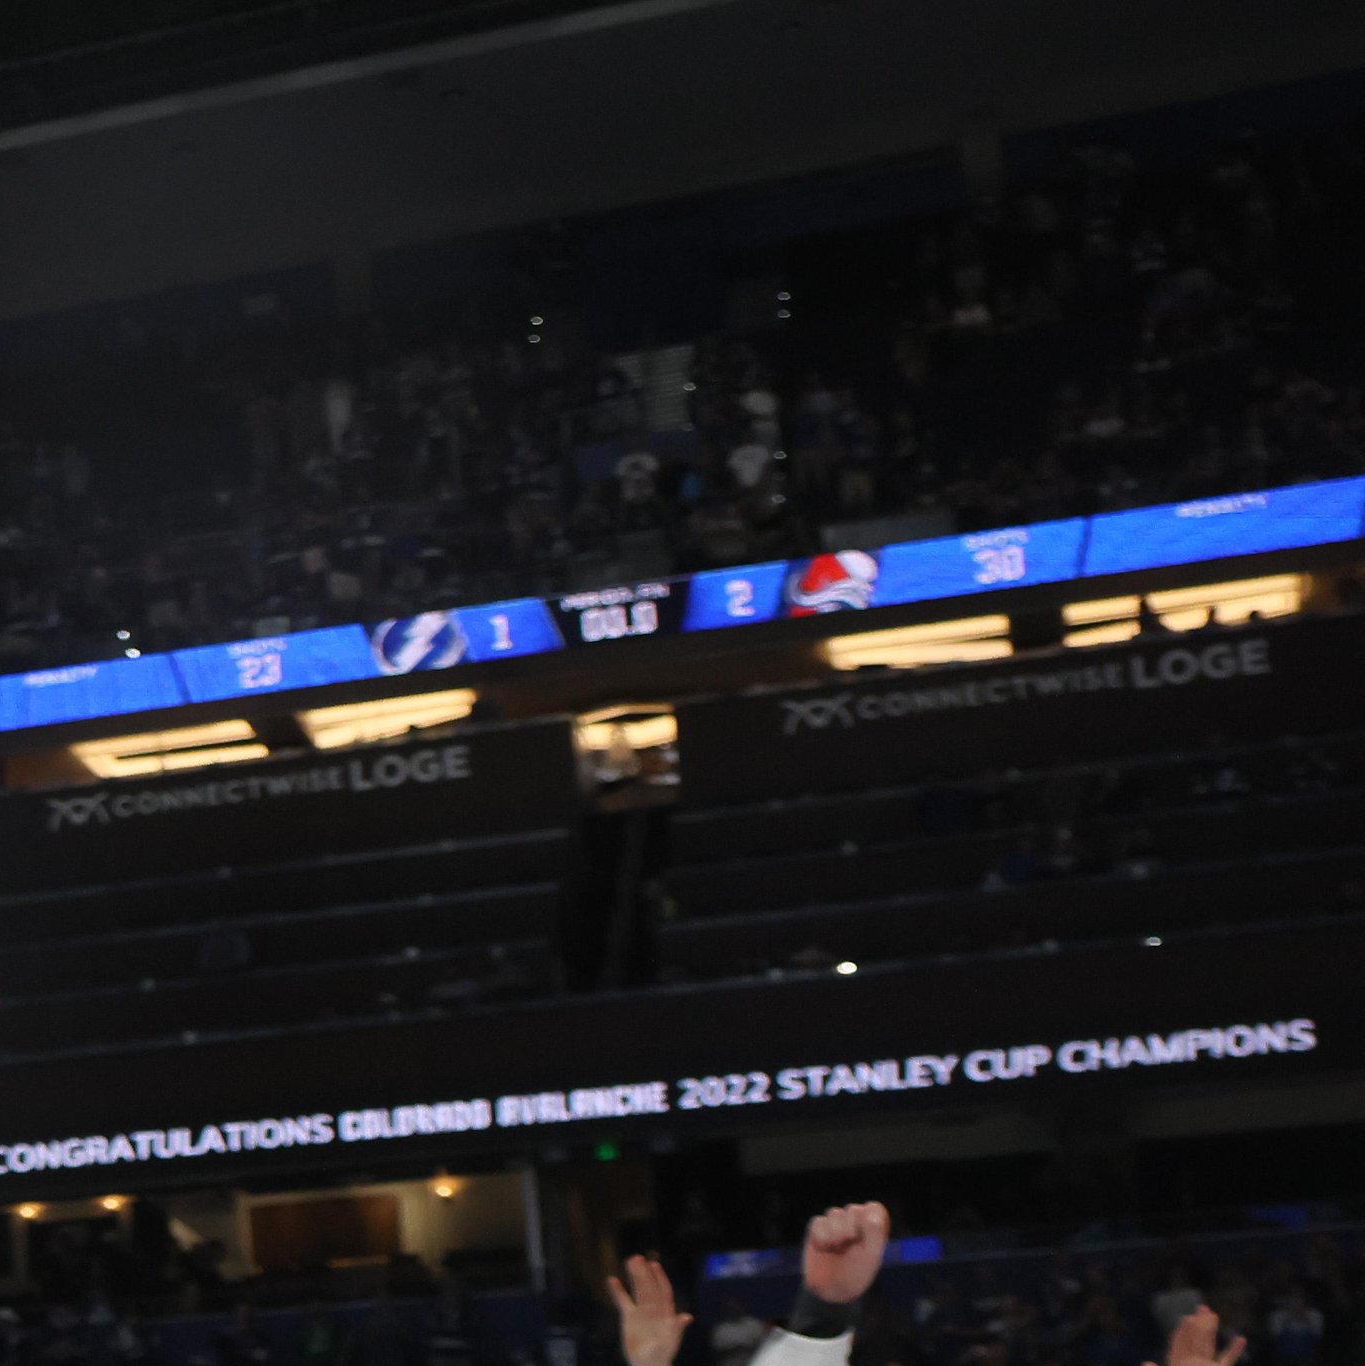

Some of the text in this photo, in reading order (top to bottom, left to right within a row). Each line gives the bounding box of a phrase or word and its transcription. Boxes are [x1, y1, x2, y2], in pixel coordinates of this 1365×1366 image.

[974, 545, 1026, 584] 30
[724, 579, 755, 617] 2
[489, 613, 514, 651] 1
[236, 652, 282, 689] 23
[855, 638, 1273, 720] CONNECTWISE LOGE
[111, 743, 473, 819] CONNECTWISE LOGE
[676, 1071, 771, 1110] 2022
[776, 1053, 961, 1100] STANLEY
[963, 1043, 1052, 1082] CUP
[1056, 1017, 1319, 1074] CHAMPIONS
